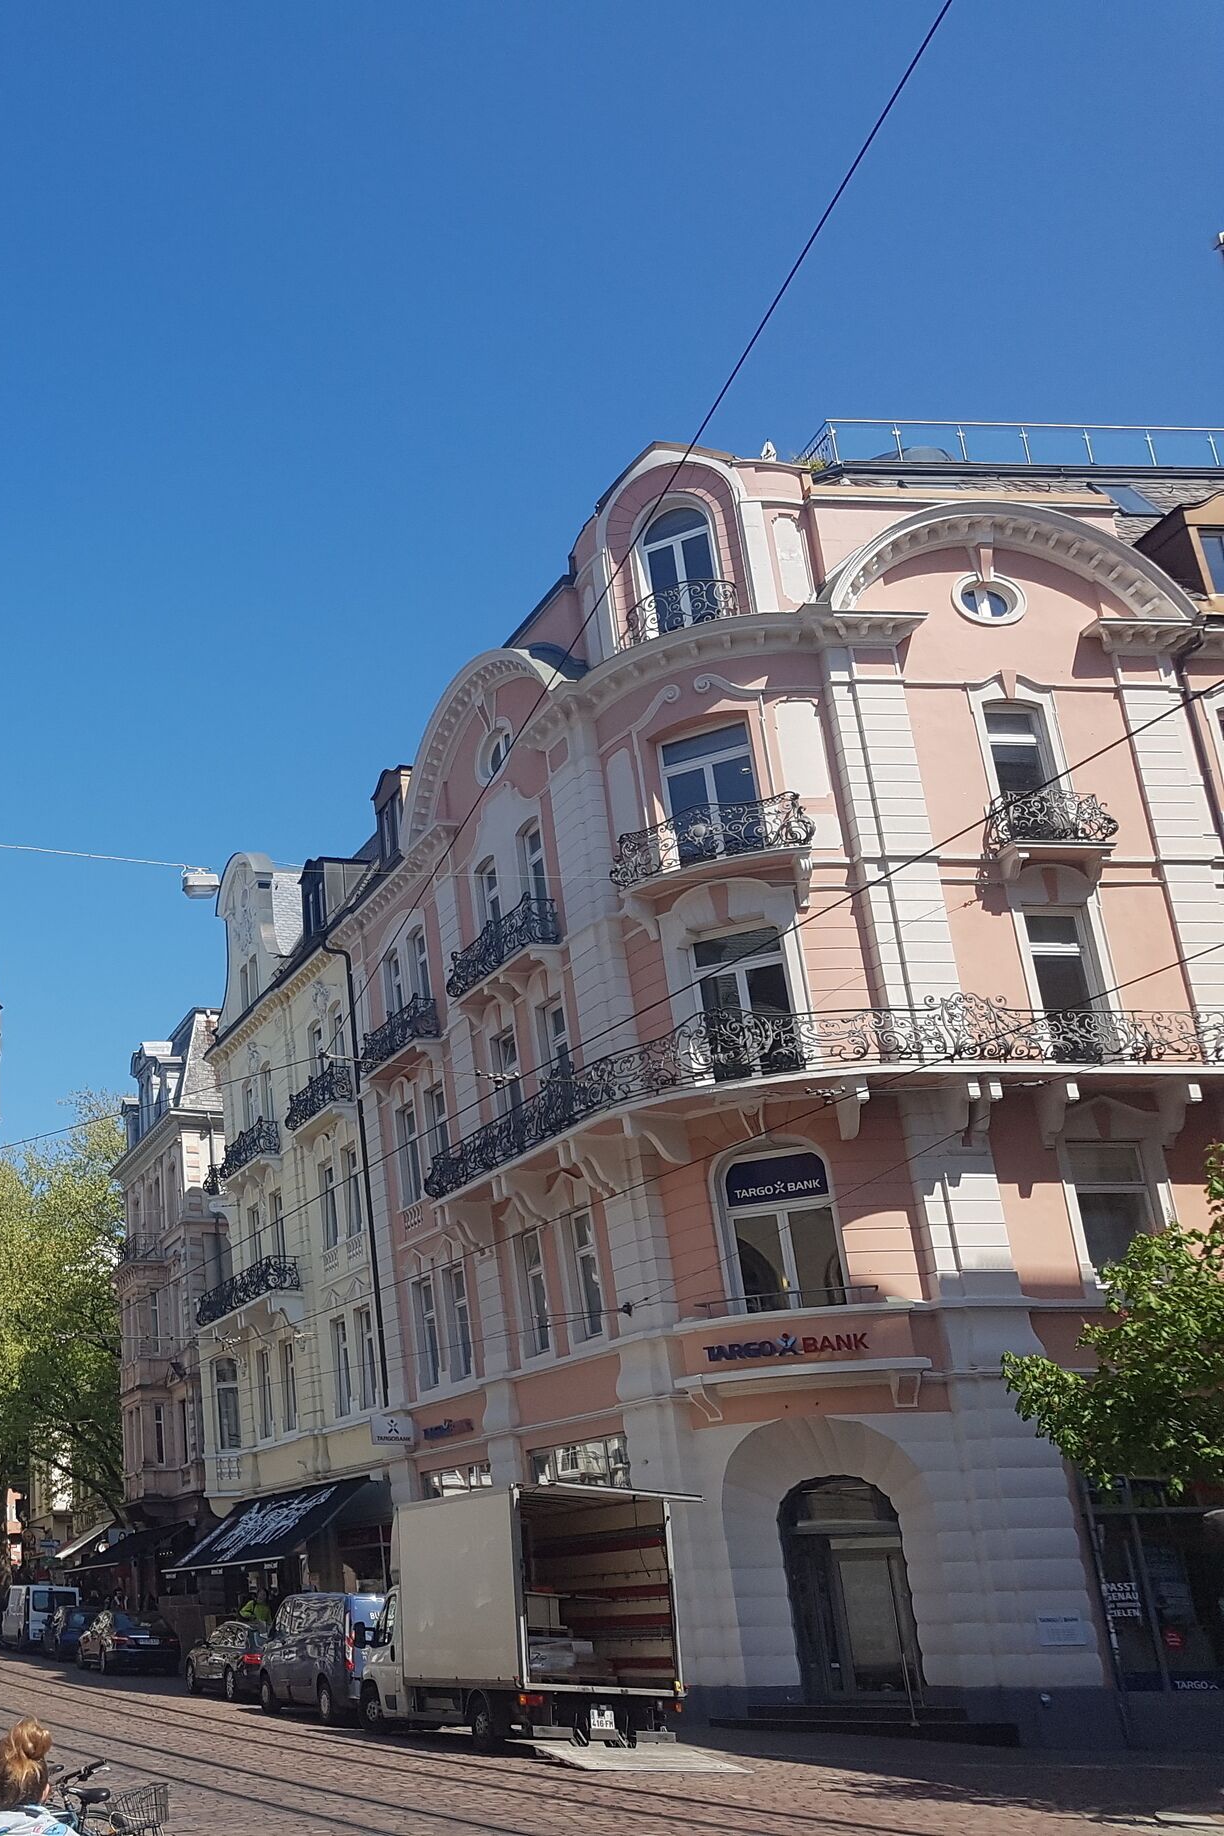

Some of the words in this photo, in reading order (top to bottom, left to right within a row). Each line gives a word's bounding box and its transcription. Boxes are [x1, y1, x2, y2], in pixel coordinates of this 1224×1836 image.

[734, 1185, 774, 1199] TARGO
[787, 1178, 821, 1192] BANK
[703, 1340, 776, 1361] TARGO
[801, 1332, 870, 1353] BANK
[1175, 1680, 1209, 1690] TARGO
